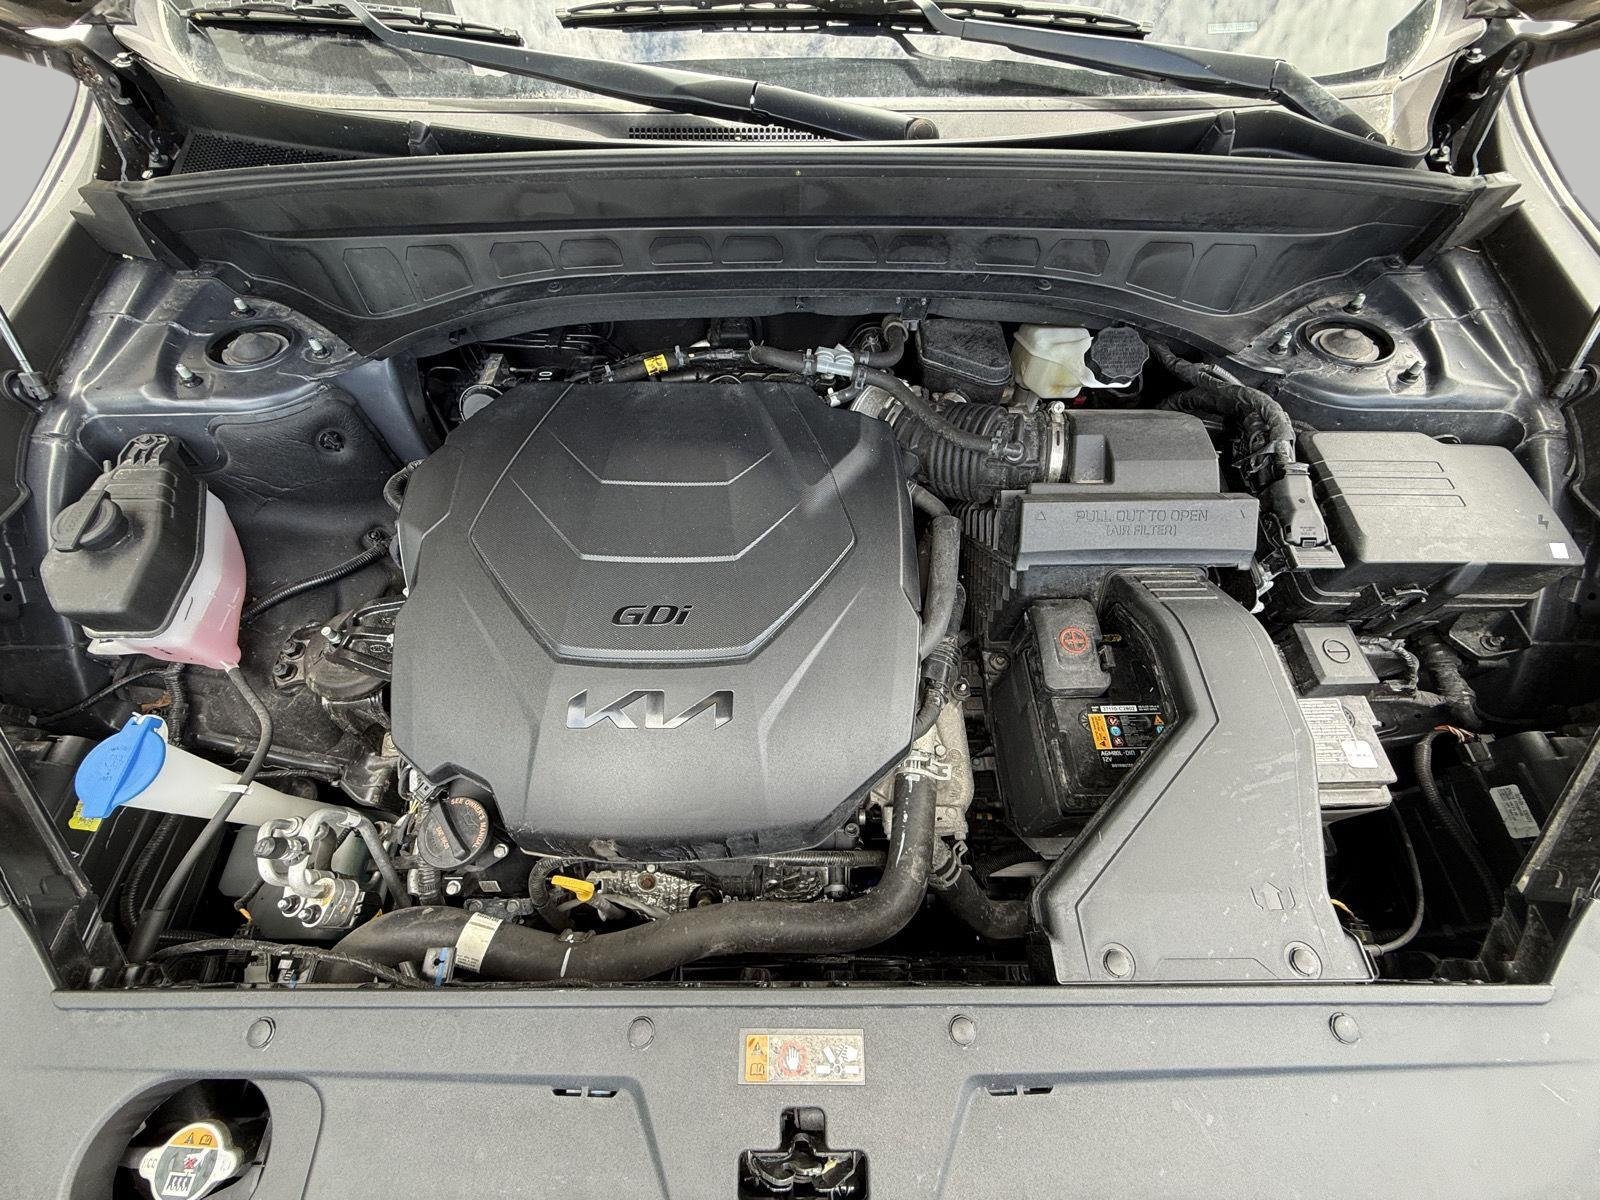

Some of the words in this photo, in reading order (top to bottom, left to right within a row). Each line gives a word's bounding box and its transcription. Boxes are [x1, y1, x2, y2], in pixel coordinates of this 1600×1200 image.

[1075, 509, 1112, 522] PULL
[1116, 509, 1145, 522] OUT
[1149, 509, 1167, 521] TO
[1170, 509, 1209, 521] OPEN
[1106, 524, 1132, 537] (AIR
[1133, 524, 1177, 536] FILTER)
[611, 604, 694, 627] GDi
[566, 688, 735, 730] KIA
[450, 797, 464, 805] SEE
[465, 798, 486, 820] OWNER'S
[471, 821, 487, 849] MANUAL
